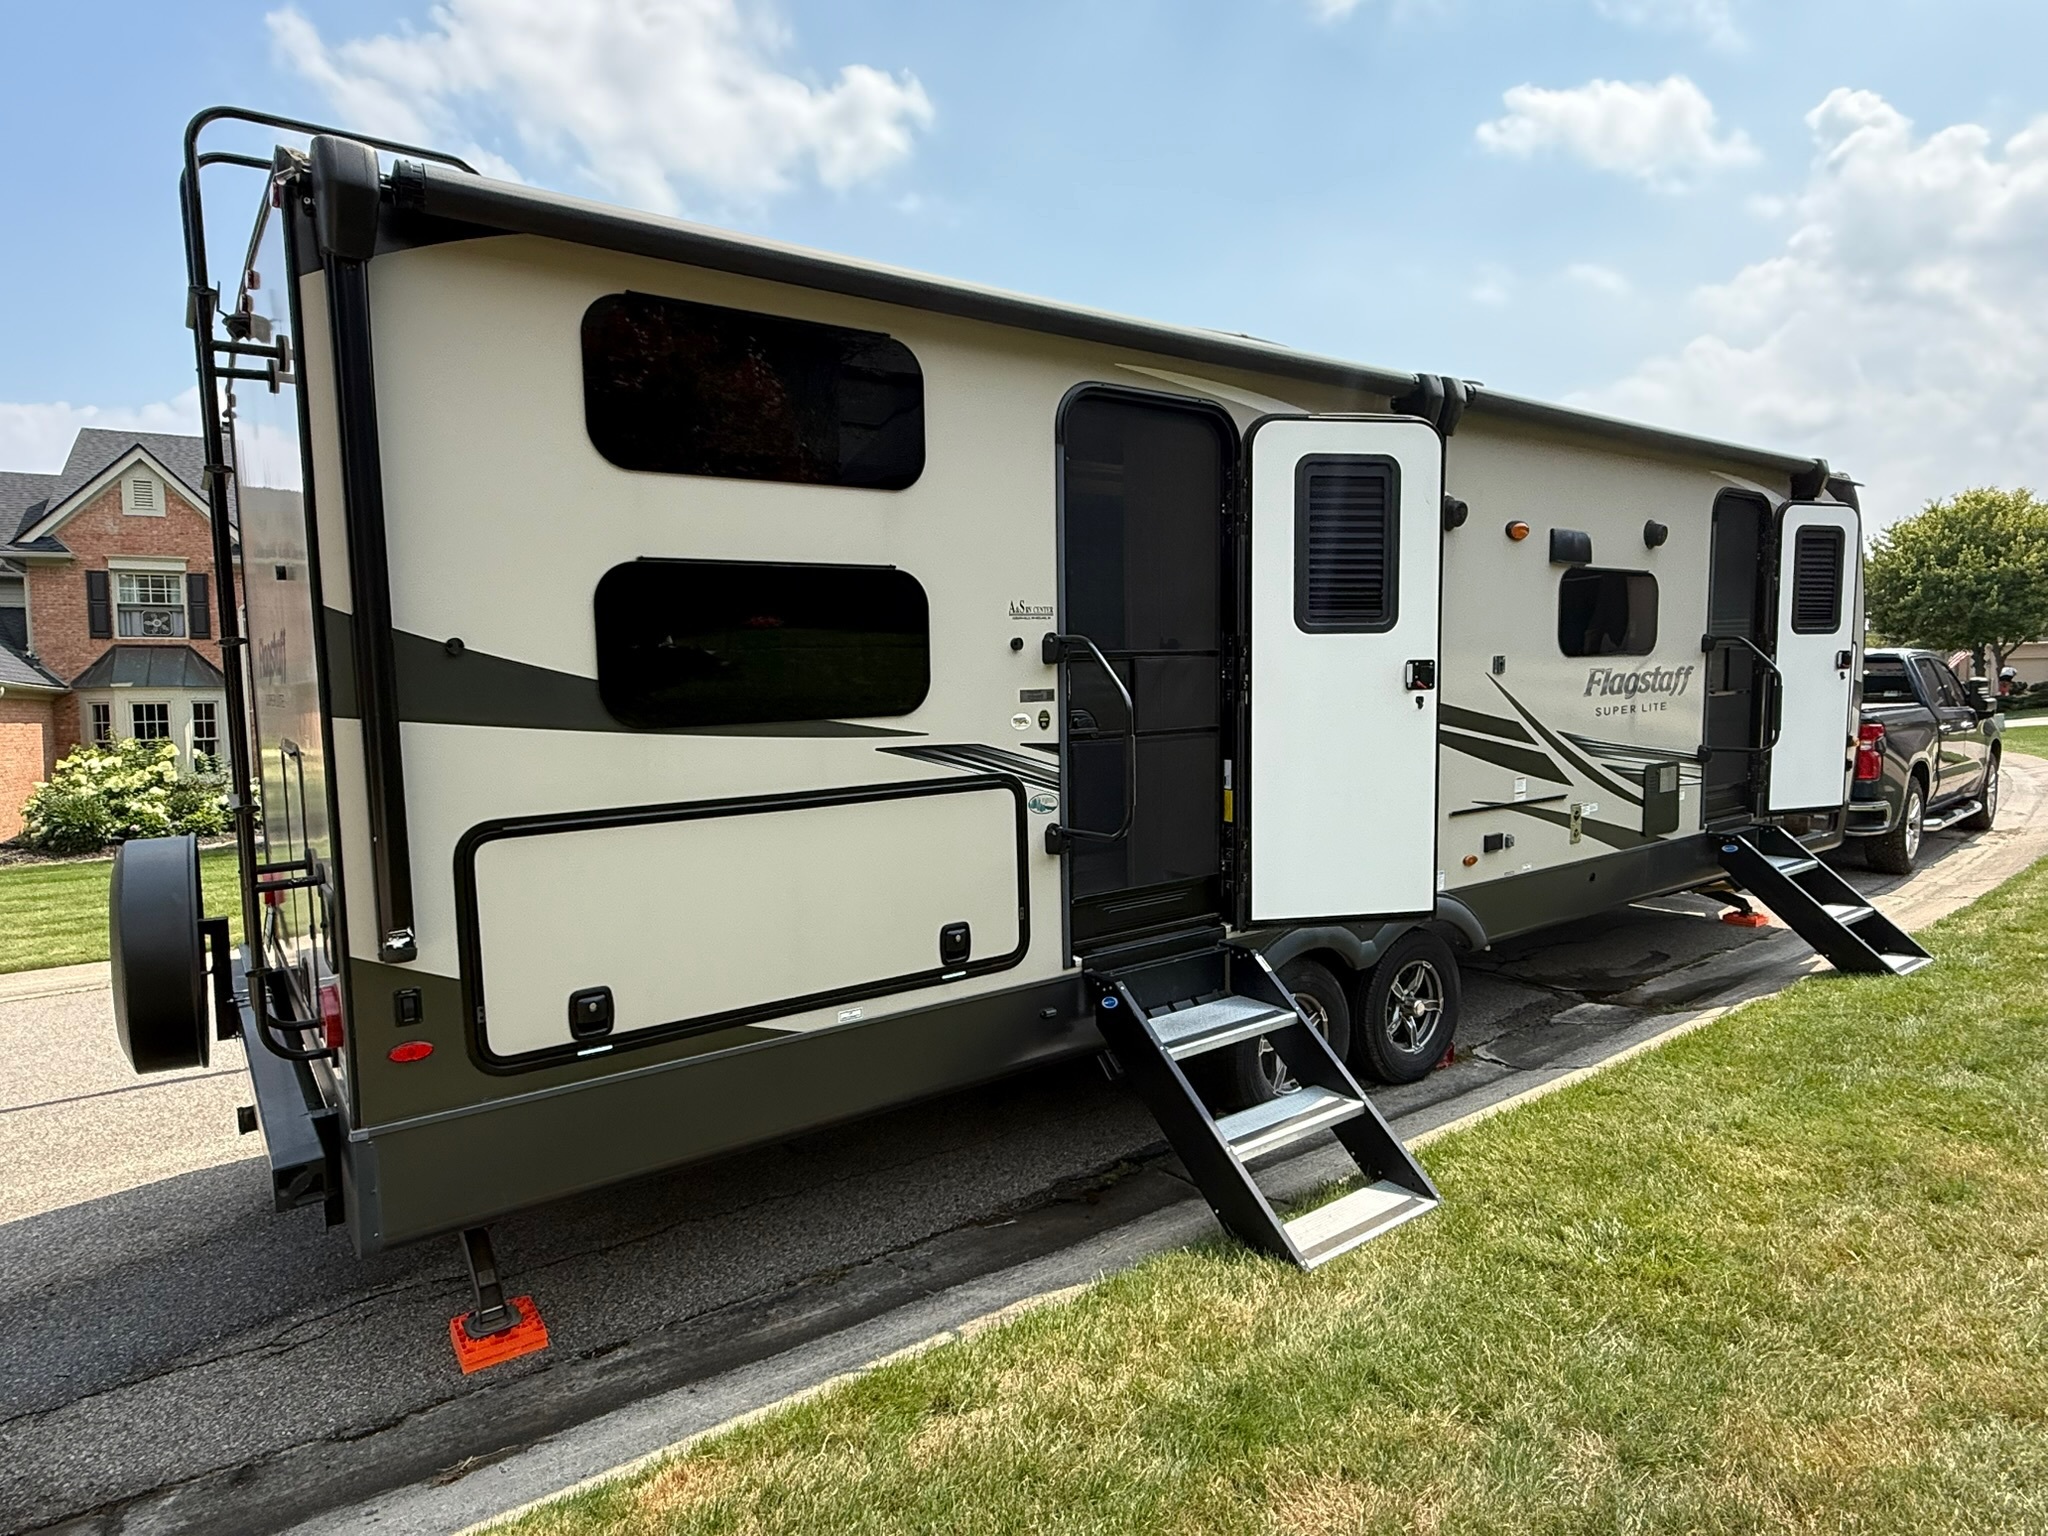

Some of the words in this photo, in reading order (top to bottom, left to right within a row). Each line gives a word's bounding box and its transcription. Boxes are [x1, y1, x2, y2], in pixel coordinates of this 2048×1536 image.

[1583, 665, 1695, 700] Flagstaff
[1595, 705, 1636, 717] SUPER
[1641, 702, 1667, 713] LITE
